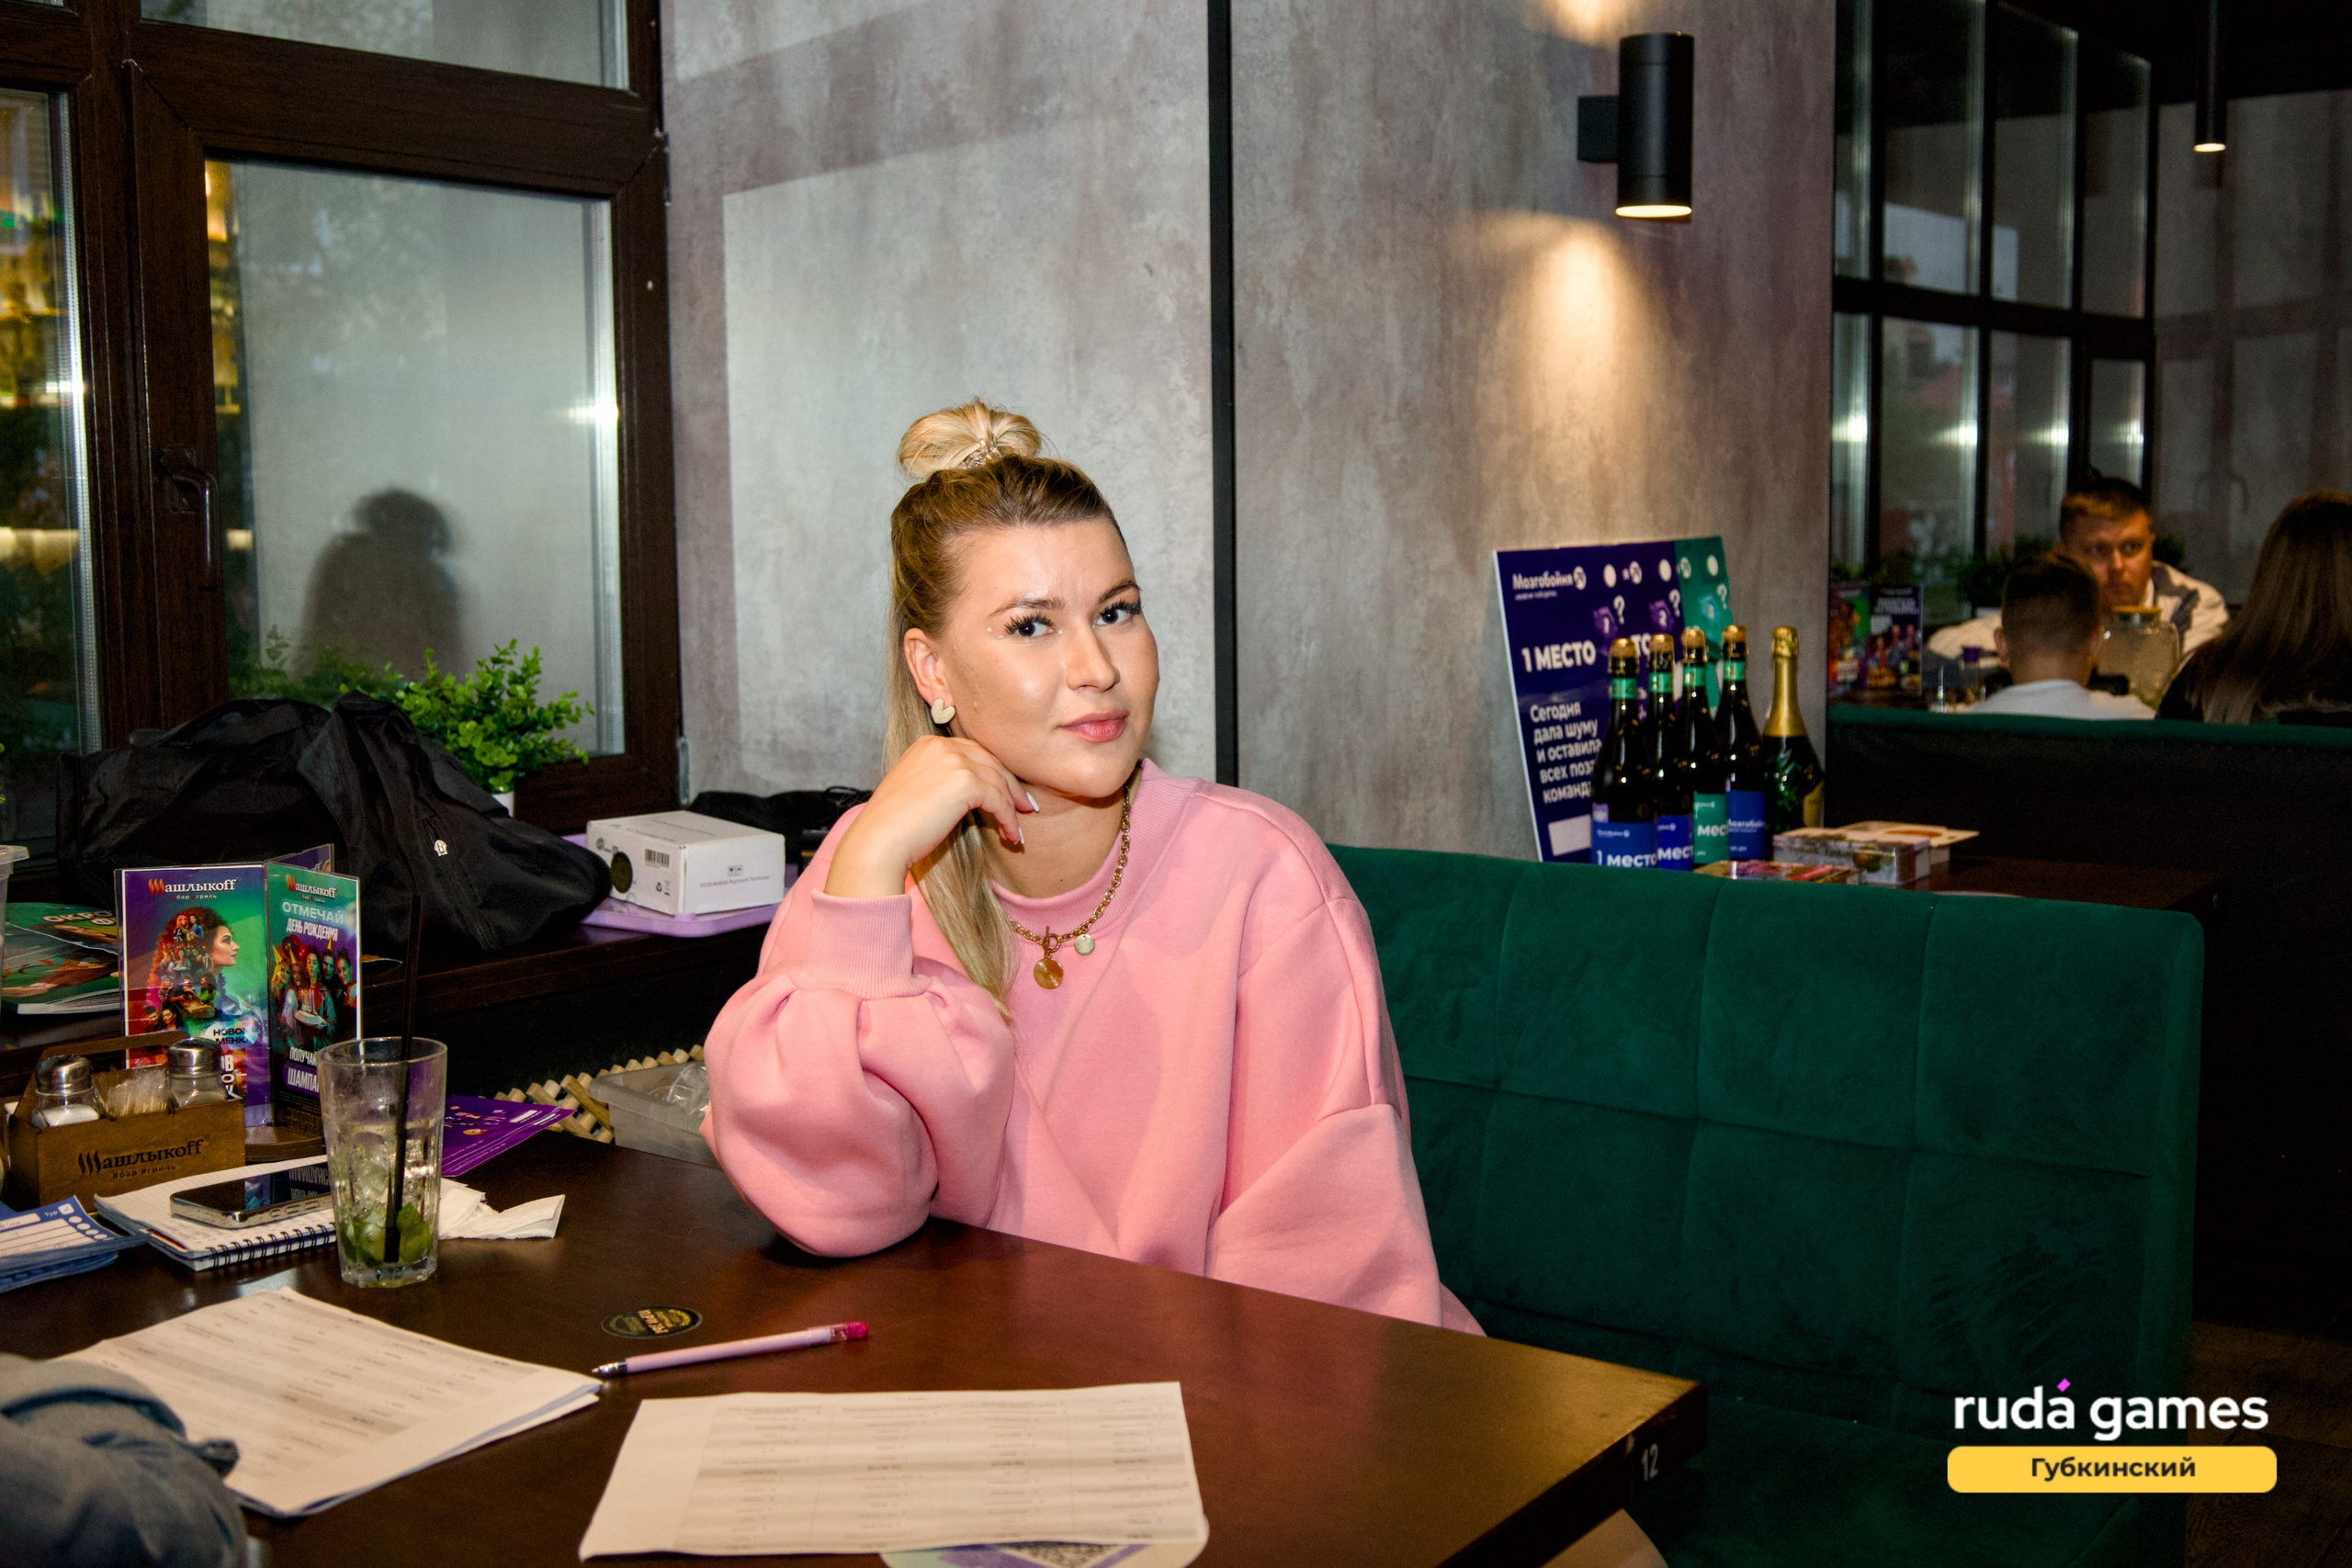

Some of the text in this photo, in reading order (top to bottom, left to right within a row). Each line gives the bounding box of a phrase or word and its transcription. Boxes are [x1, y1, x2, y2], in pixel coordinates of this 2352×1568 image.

[1512, 570, 1574, 591] Мозгобойня
[1521, 648, 1532, 672] 1
[1533, 640, 1597, 671] МЕСТО
[1530, 702, 1581, 723] Сегодня
[1533, 719, 1598, 746] дала шуму
[1536, 748, 1546, 763] и
[1539, 764, 1568, 784] всех
[1596, 850, 1602, 865] 1
[282, 901, 345, 925] ОТМЕЧАЙ
[286, 918, 339, 942] ДЕНЬ РОЖДЕНИЯ
[1641, 1443, 1659, 1483] 12
